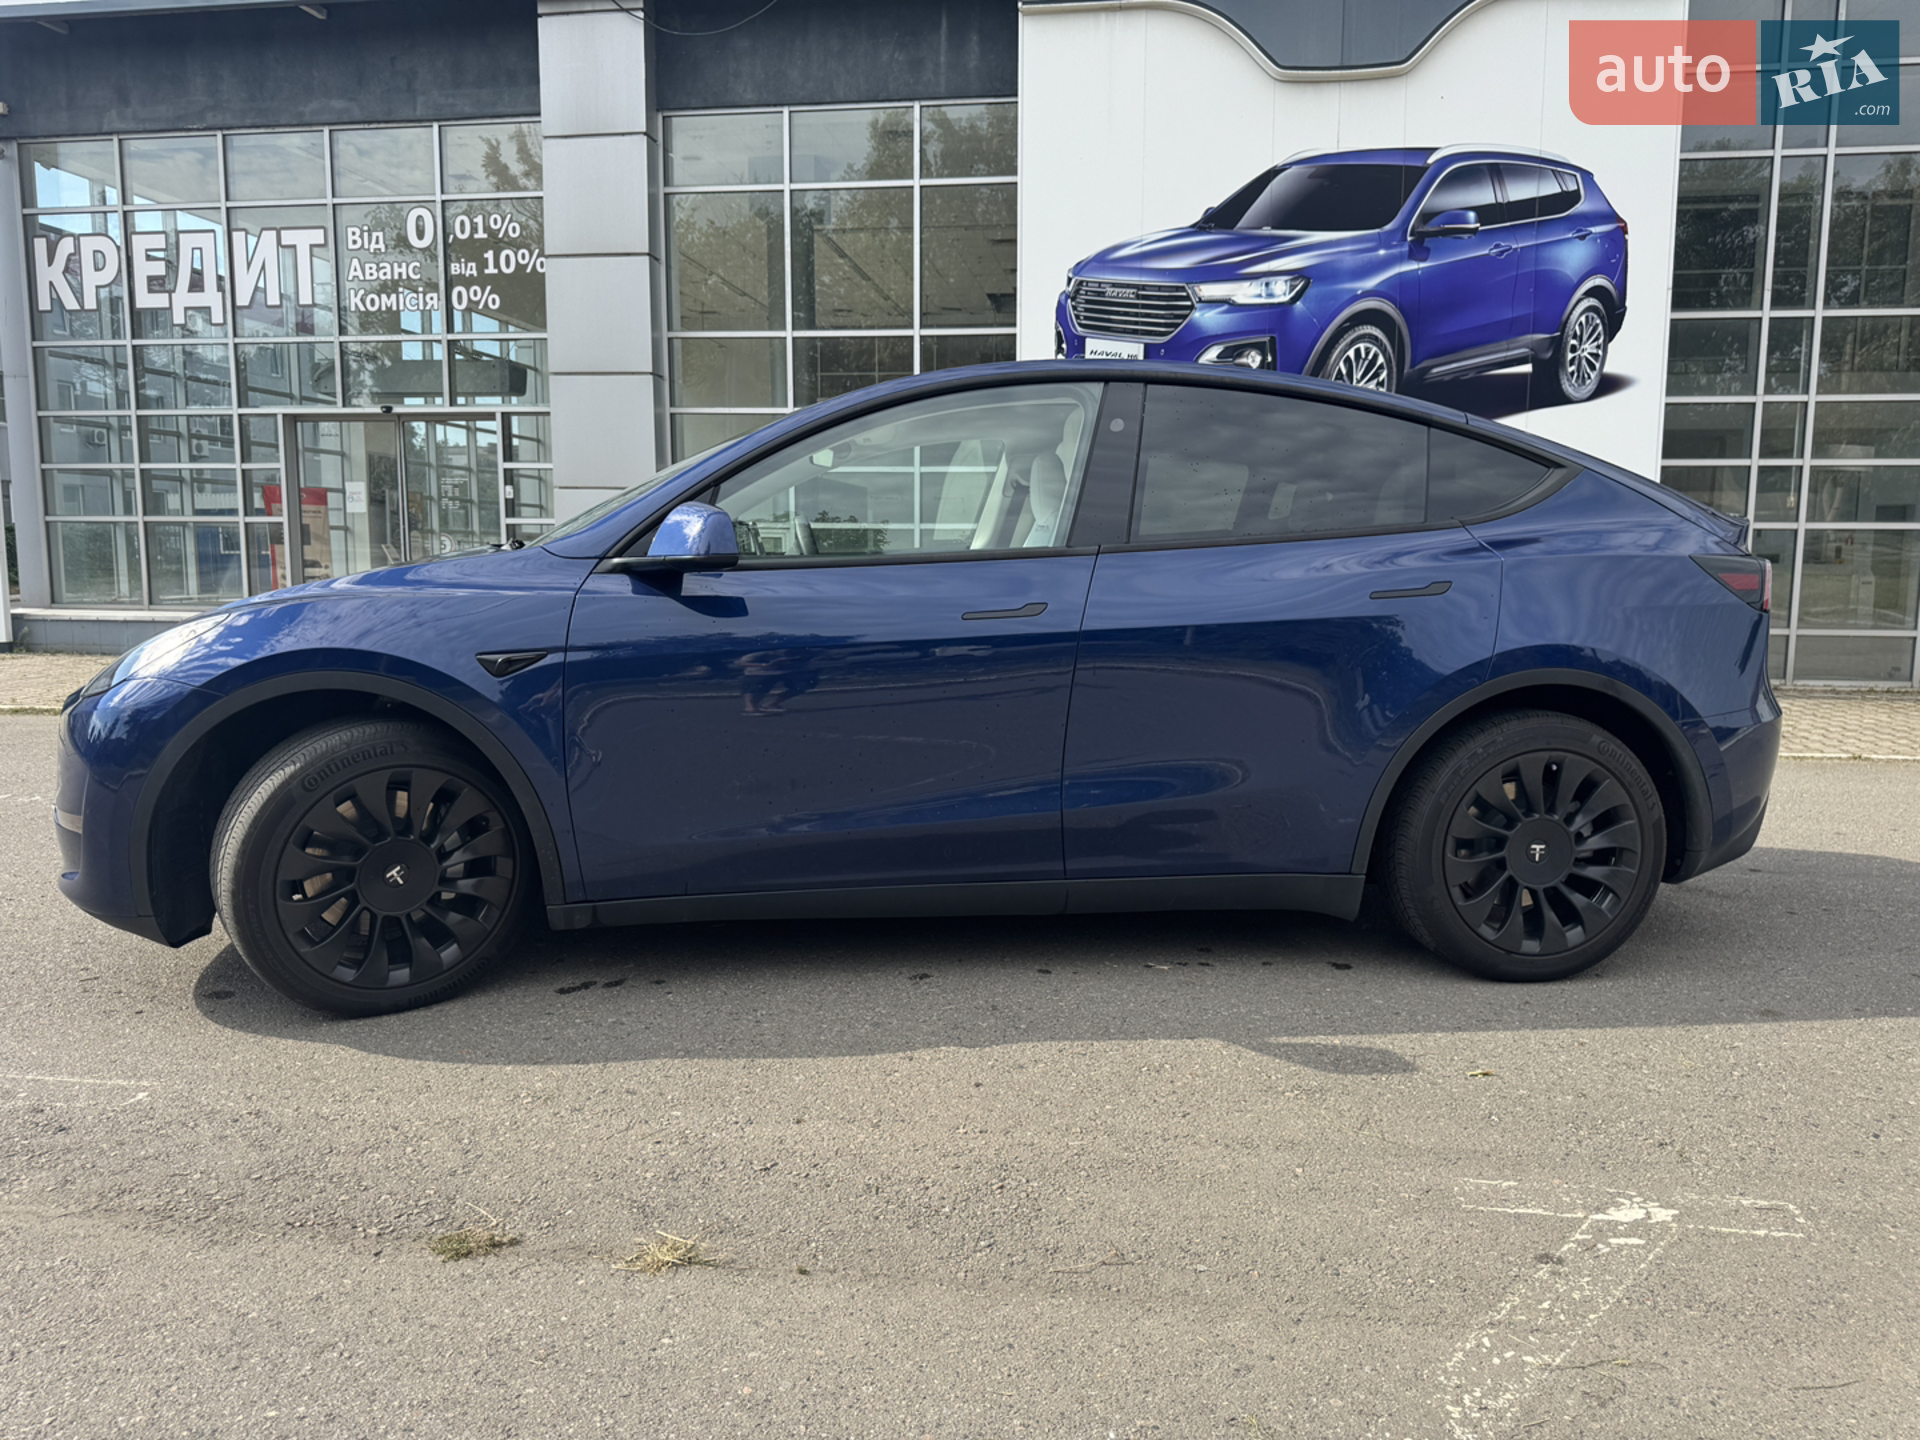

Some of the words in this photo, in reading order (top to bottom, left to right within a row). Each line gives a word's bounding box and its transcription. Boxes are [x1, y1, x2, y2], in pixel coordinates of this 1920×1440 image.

[346, 225, 386, 253] Від
[32, 226, 326, 326] КРЕДИТ
[347, 258, 421, 281] Аванс
[450, 259, 477, 277] від
[483, 248, 546, 275] 10%
[349, 287, 440, 312] Комісія
[451, 285, 501, 310] 0%
[1105, 287, 1138, 299] HAVAL
[1089, 349, 1125, 358] HAVAL
[301, 742, 395, 793] Continental
[1597, 740, 1653, 802] Continental
